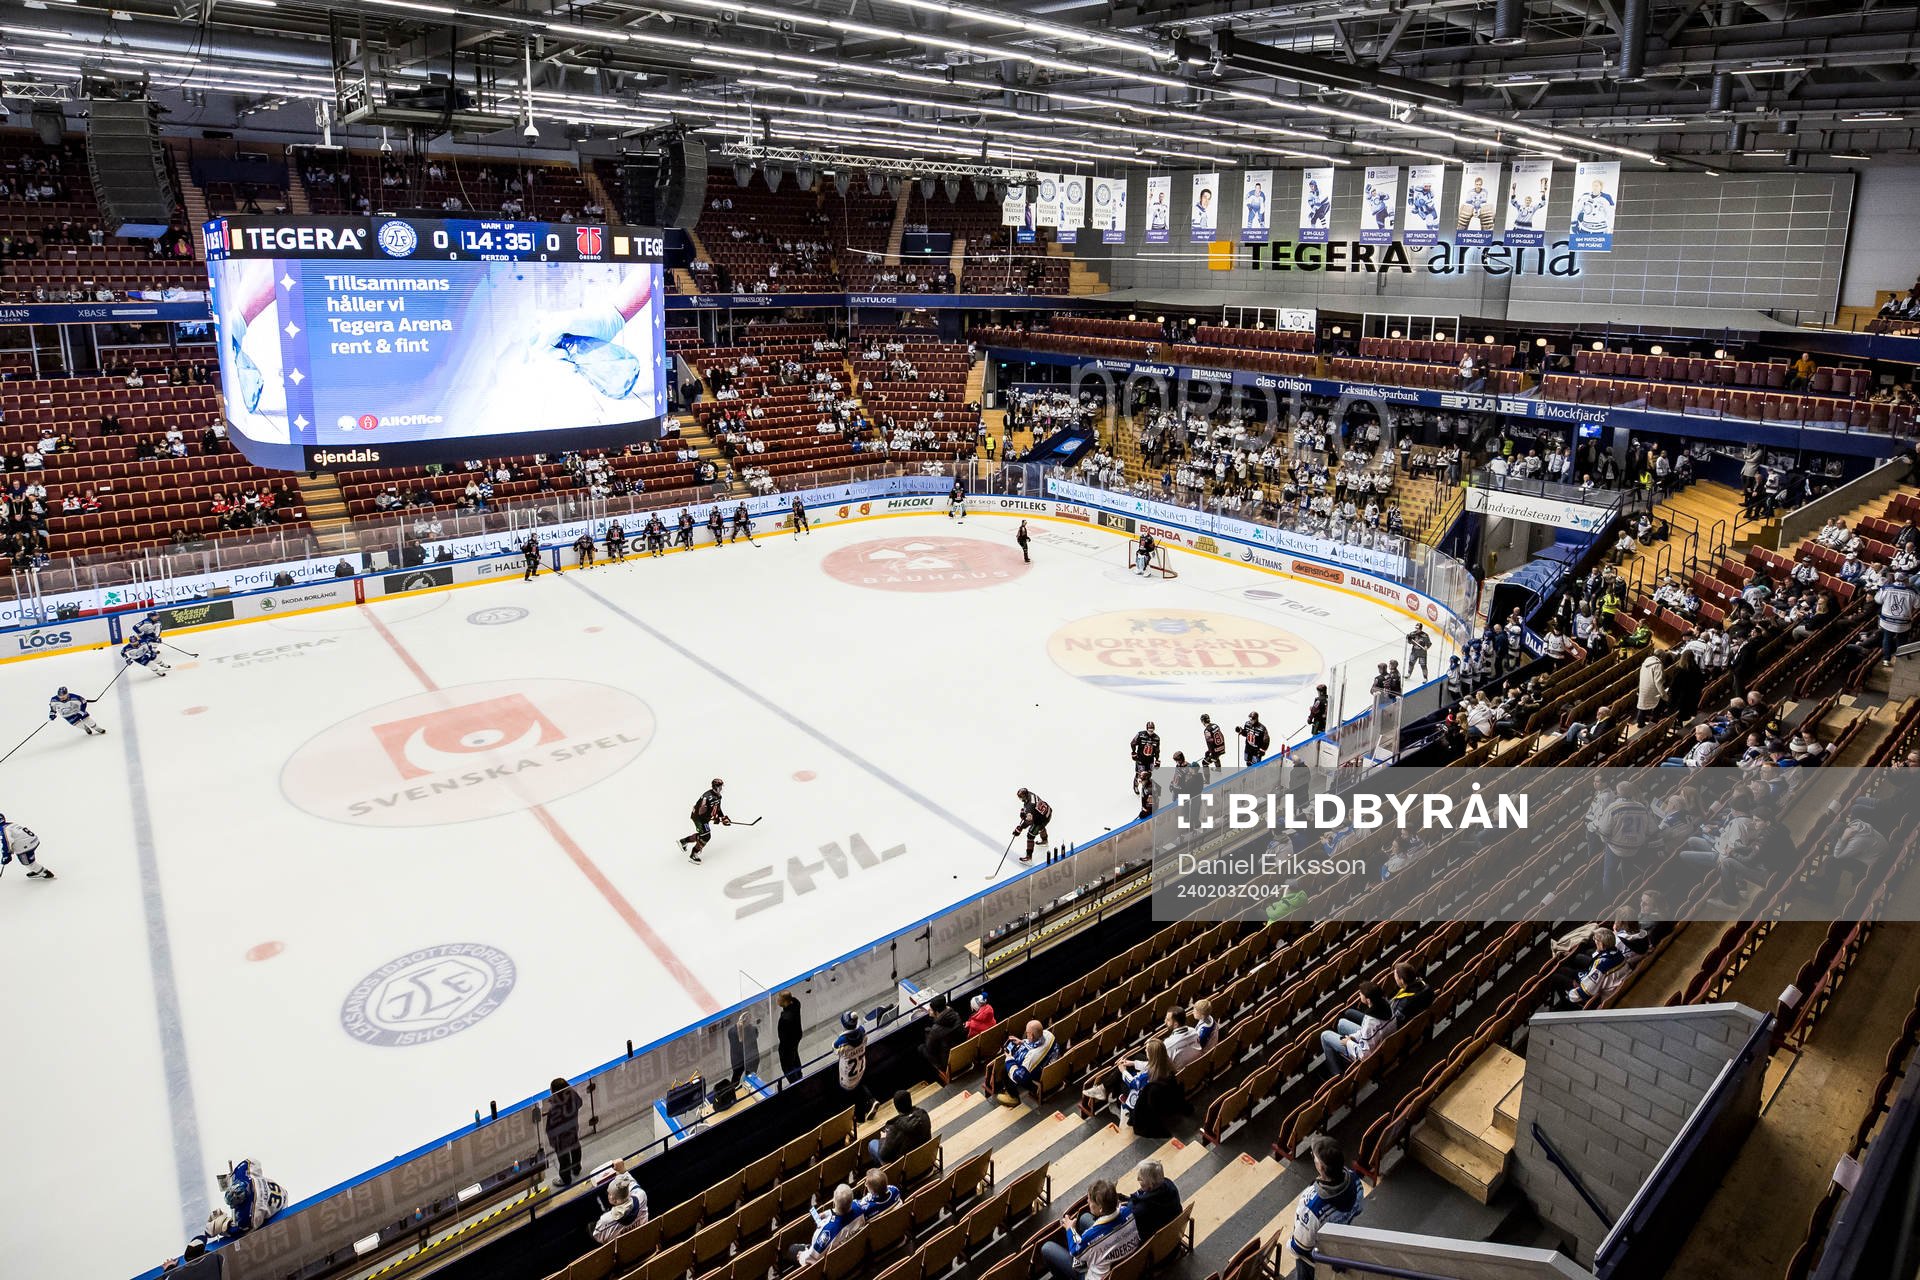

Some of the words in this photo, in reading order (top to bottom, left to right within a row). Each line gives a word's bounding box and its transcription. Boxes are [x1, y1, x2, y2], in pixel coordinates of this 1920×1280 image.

[433, 230, 448, 249] 0
[466, 232, 531, 250] 14:35
[546, 234, 560, 250] 0
[450, 252, 457, 260] 0
[324, 274, 450, 291] Tillsammans
[326, 295, 386, 312] håller
[386, 296, 405, 312] vi
[851, 296, 897, 304] BASTULOGE
[78, 308, 108, 317] XBASE
[328, 318, 394, 336] Tegera
[398, 317, 453, 332] Arena
[330, 340, 372, 354] rent
[376, 338, 392, 354] &
[394, 338, 430, 353] fint
[1255, 376, 1276, 387] clas
[1278, 378, 1312, 392] ohlson
[1339, 384, 1378, 397] Leksands
[1378, 388, 1420, 401] Sparbank
[1450, 395, 1517, 414] PEAB
[380, 414, 444, 428] AllOffice
[313, 449, 380, 466] ejendals
[1000, 499, 1047, 512] OPTILEKS
[1140, 524, 1182, 542] BORGA
[1265, 530, 1319, 553] bokstaven
[602, 531, 689, 555] EGERA
[863, 570, 1009, 584] BAUHAUS
[1350, 576, 1401, 600] DALA-GRIPEN
[1280, 598, 1331, 617] Telia
[1064, 637, 1299, 653] NORRLANDS
[1095, 648, 1281, 669] GULD
[347, 758, 544, 817] SVENSKA
[550, 733, 641, 762] SPEL
[723, 832, 907, 920] SHL
[394, 998, 500, 1046] ISHOCKEY
[267, 1181, 282, 1209] 39
